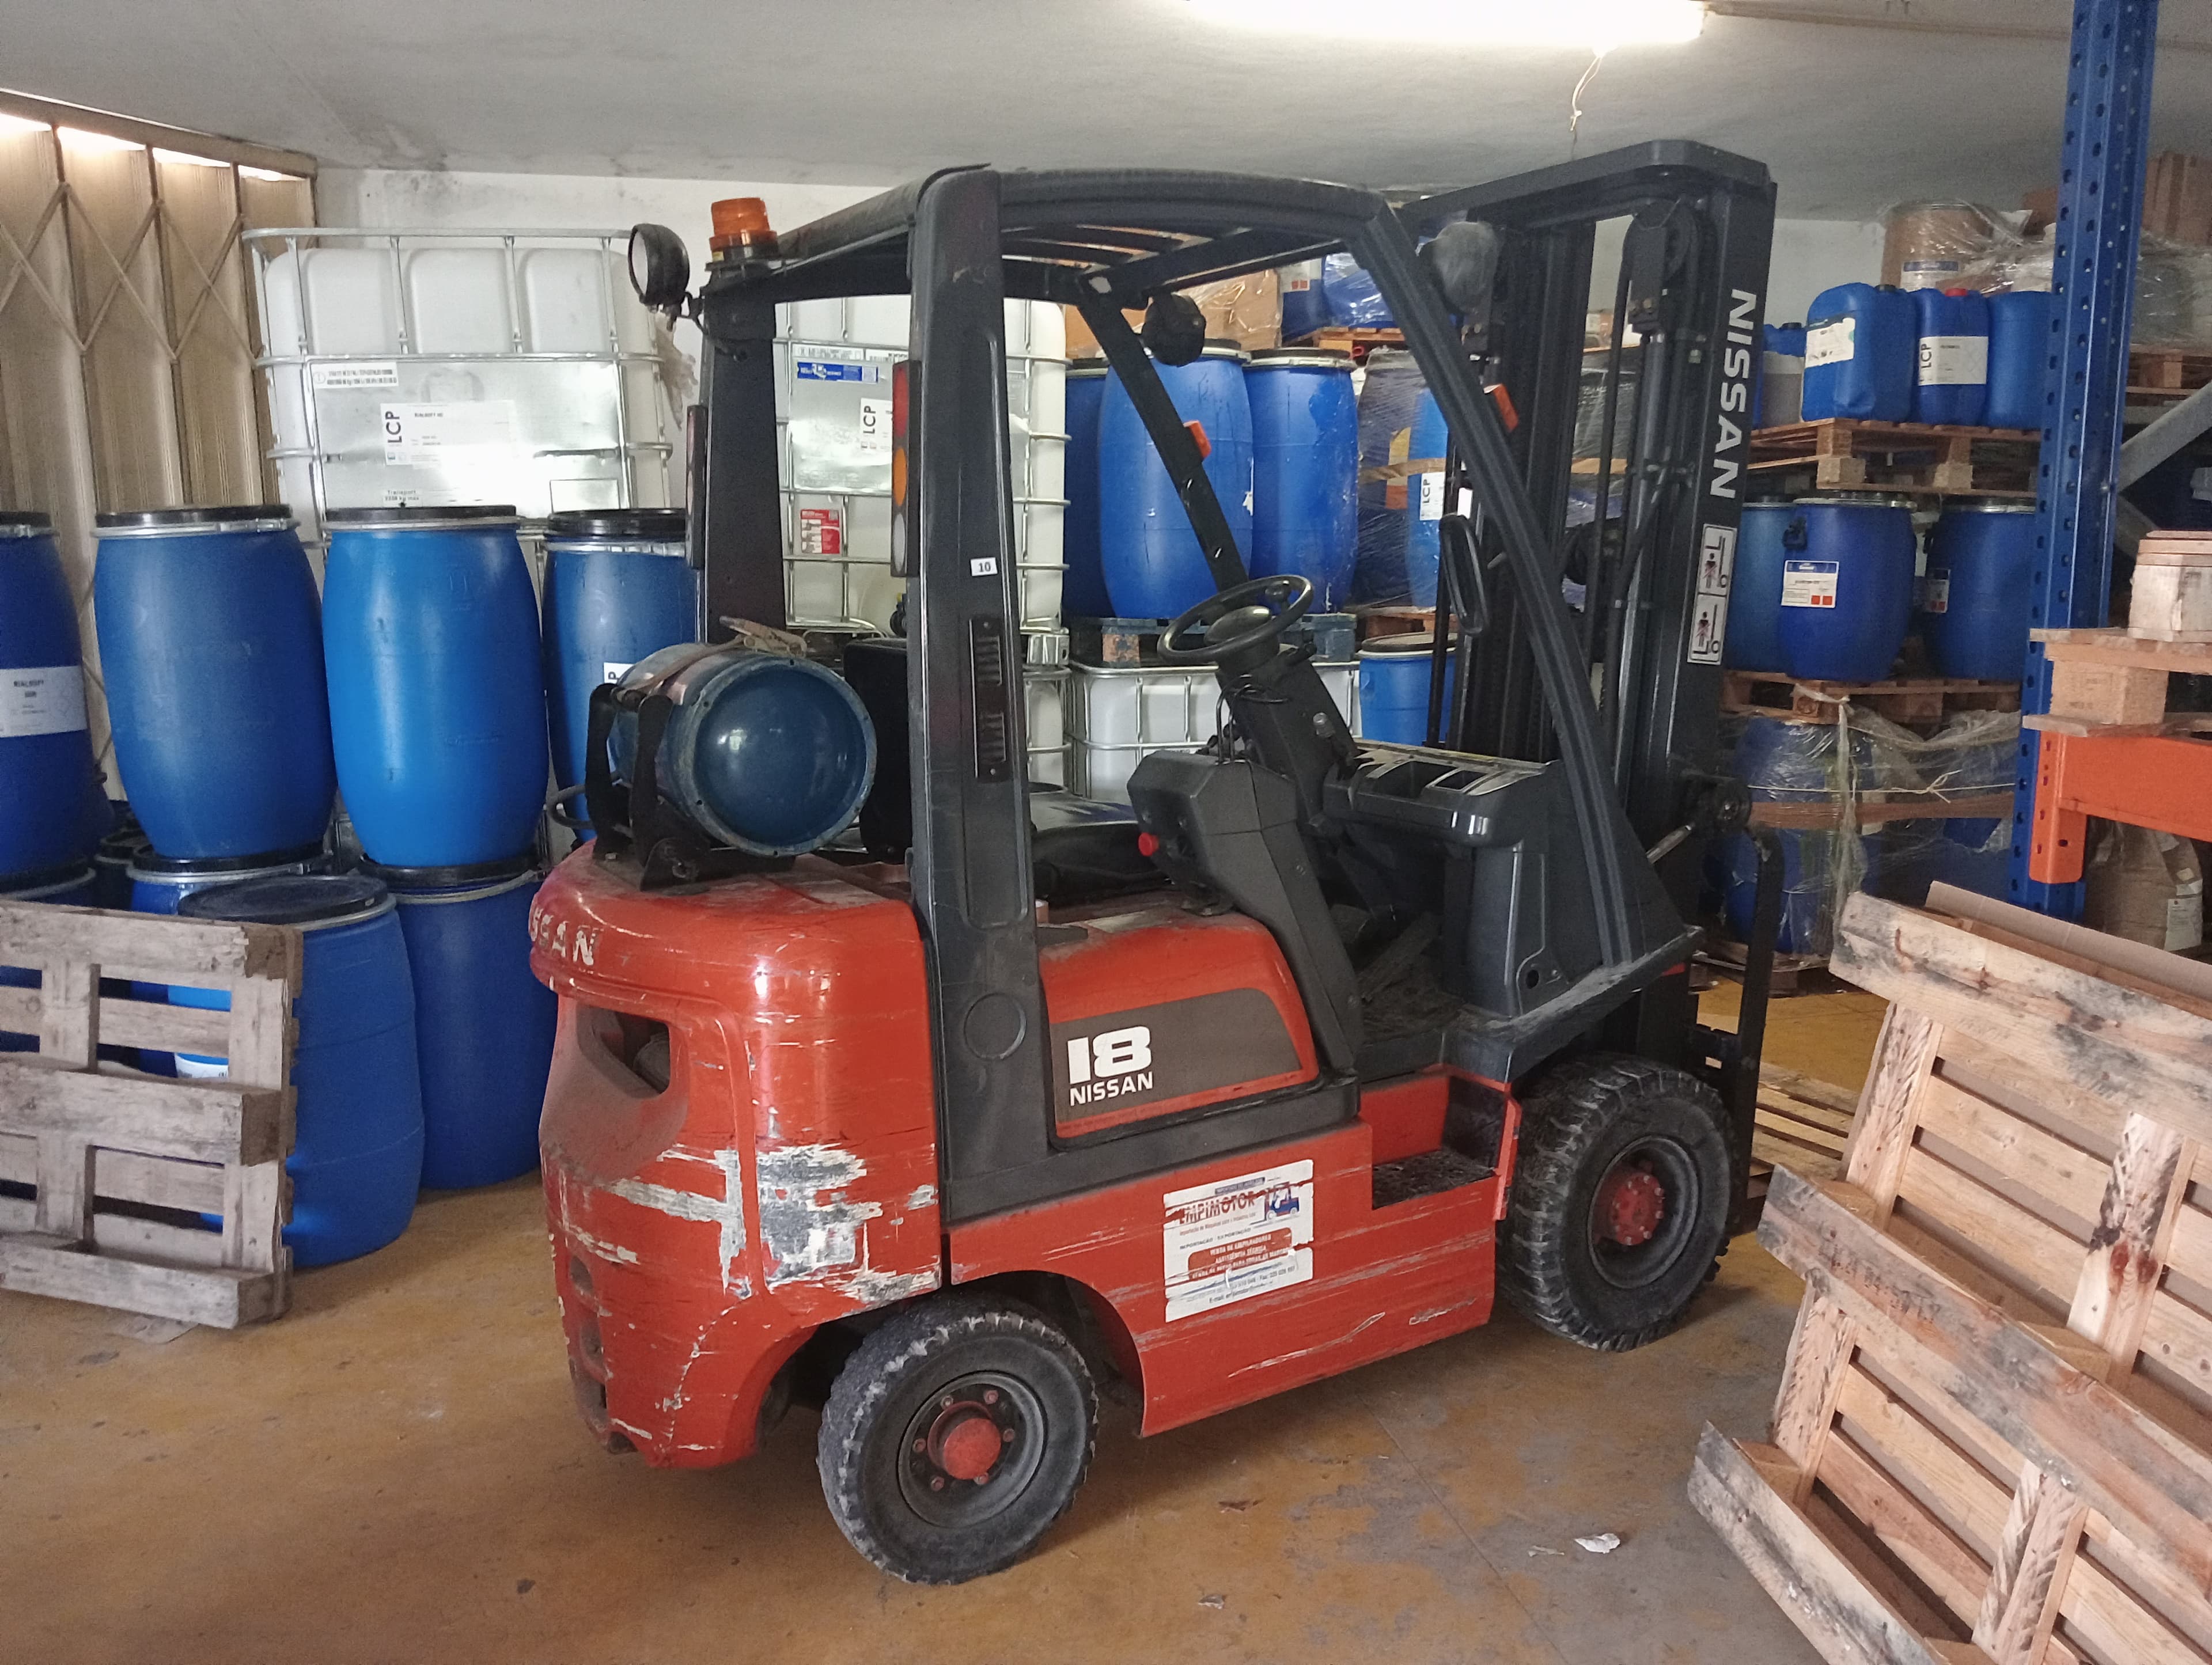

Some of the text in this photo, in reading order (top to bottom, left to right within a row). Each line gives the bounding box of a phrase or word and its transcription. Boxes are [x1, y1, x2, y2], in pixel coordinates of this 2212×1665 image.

[1921, 343, 1932, 369] LCP
[1710, 289, 1757, 499] NISSAN
[385, 411, 402, 443] LCP
[863, 405, 876, 434] LCP
[1422, 479, 1431, 503] LCP
[979, 562, 991, 572] 10
[1067, 1025, 1152, 1085] 18
[1070, 1071, 1153, 1106] NISSAN
